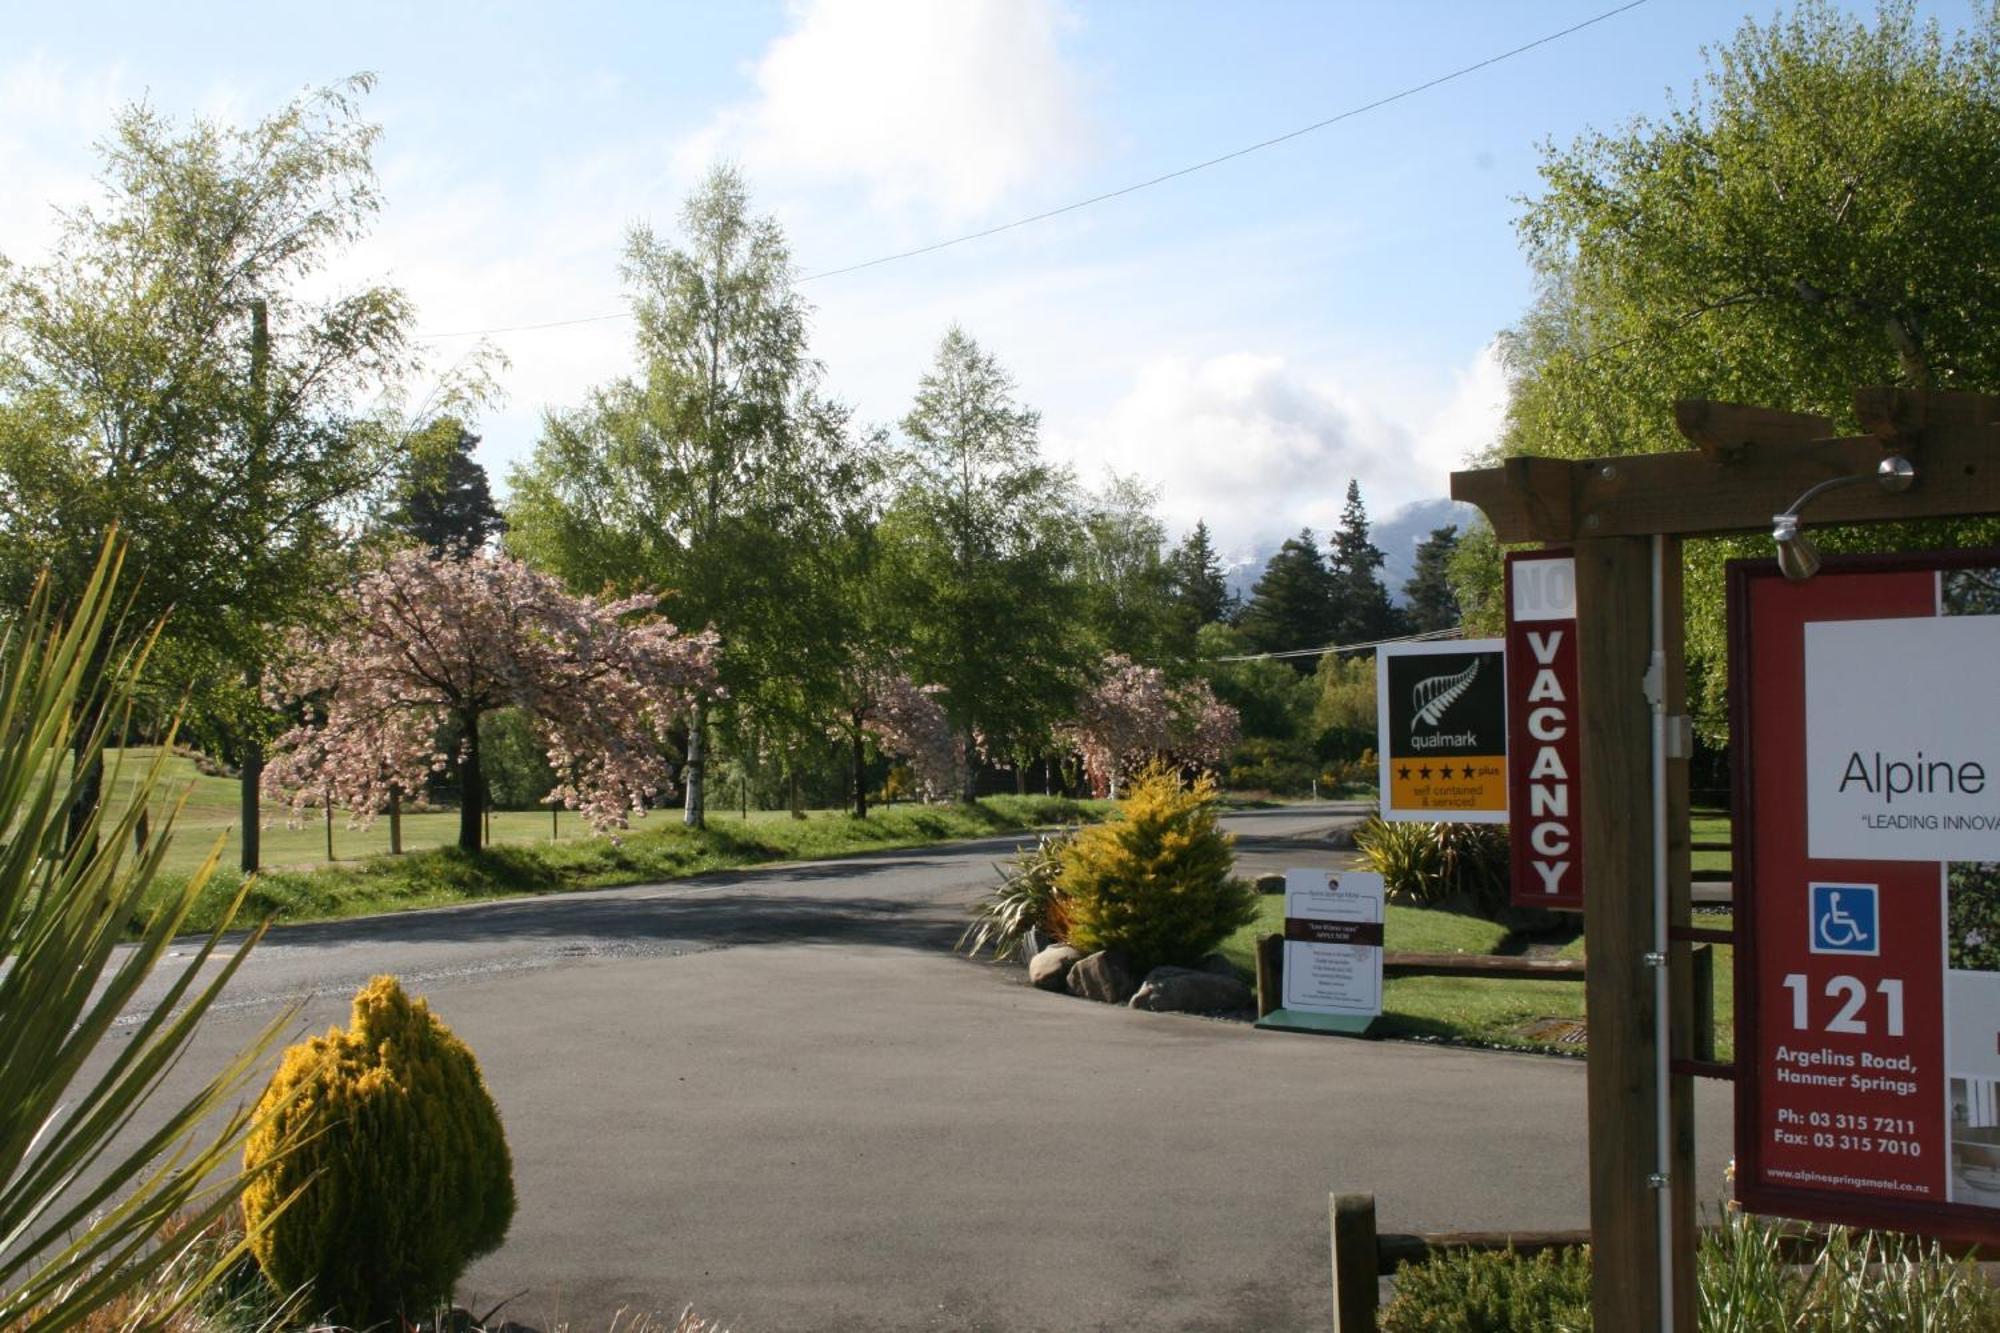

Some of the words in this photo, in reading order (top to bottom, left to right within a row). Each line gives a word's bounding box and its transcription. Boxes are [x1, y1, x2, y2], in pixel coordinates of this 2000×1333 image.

[1517, 565, 1573, 611] NO
[1411, 730, 1477, 751] qualmark
[1478, 766, 1500, 778] plus
[1527, 631, 1570, 894] VACANCY
[1414, 784, 1430, 795] self
[1434, 784, 1483, 795] contained
[1838, 751, 1985, 804] Alpine
[1432, 796, 1475, 807] serviced
[1782, 973, 1905, 1037] 121
[1775, 1046, 1855, 1067] Argelins
[1861, 1052, 1918, 1073] Road,
[1777, 1068, 1845, 1087] Hanmer
[1850, 1074, 1917, 1096] Springs
[1778, 1108, 1804, 1125] Ph:
[1809, 1111, 1831, 1126] 03
[1836, 1114, 1867, 1130] 315
[1874, 1117, 1915, 1135] 7211
[1774, 1129, 1808, 1146] Fax:
[1813, 1133, 1834, 1148] 03
[1839, 1135, 1872, 1152] 315
[1877, 1138, 1921, 1157] 7010
[1767, 1168, 1929, 1193] www.alpinespringsmotel.co.nz
